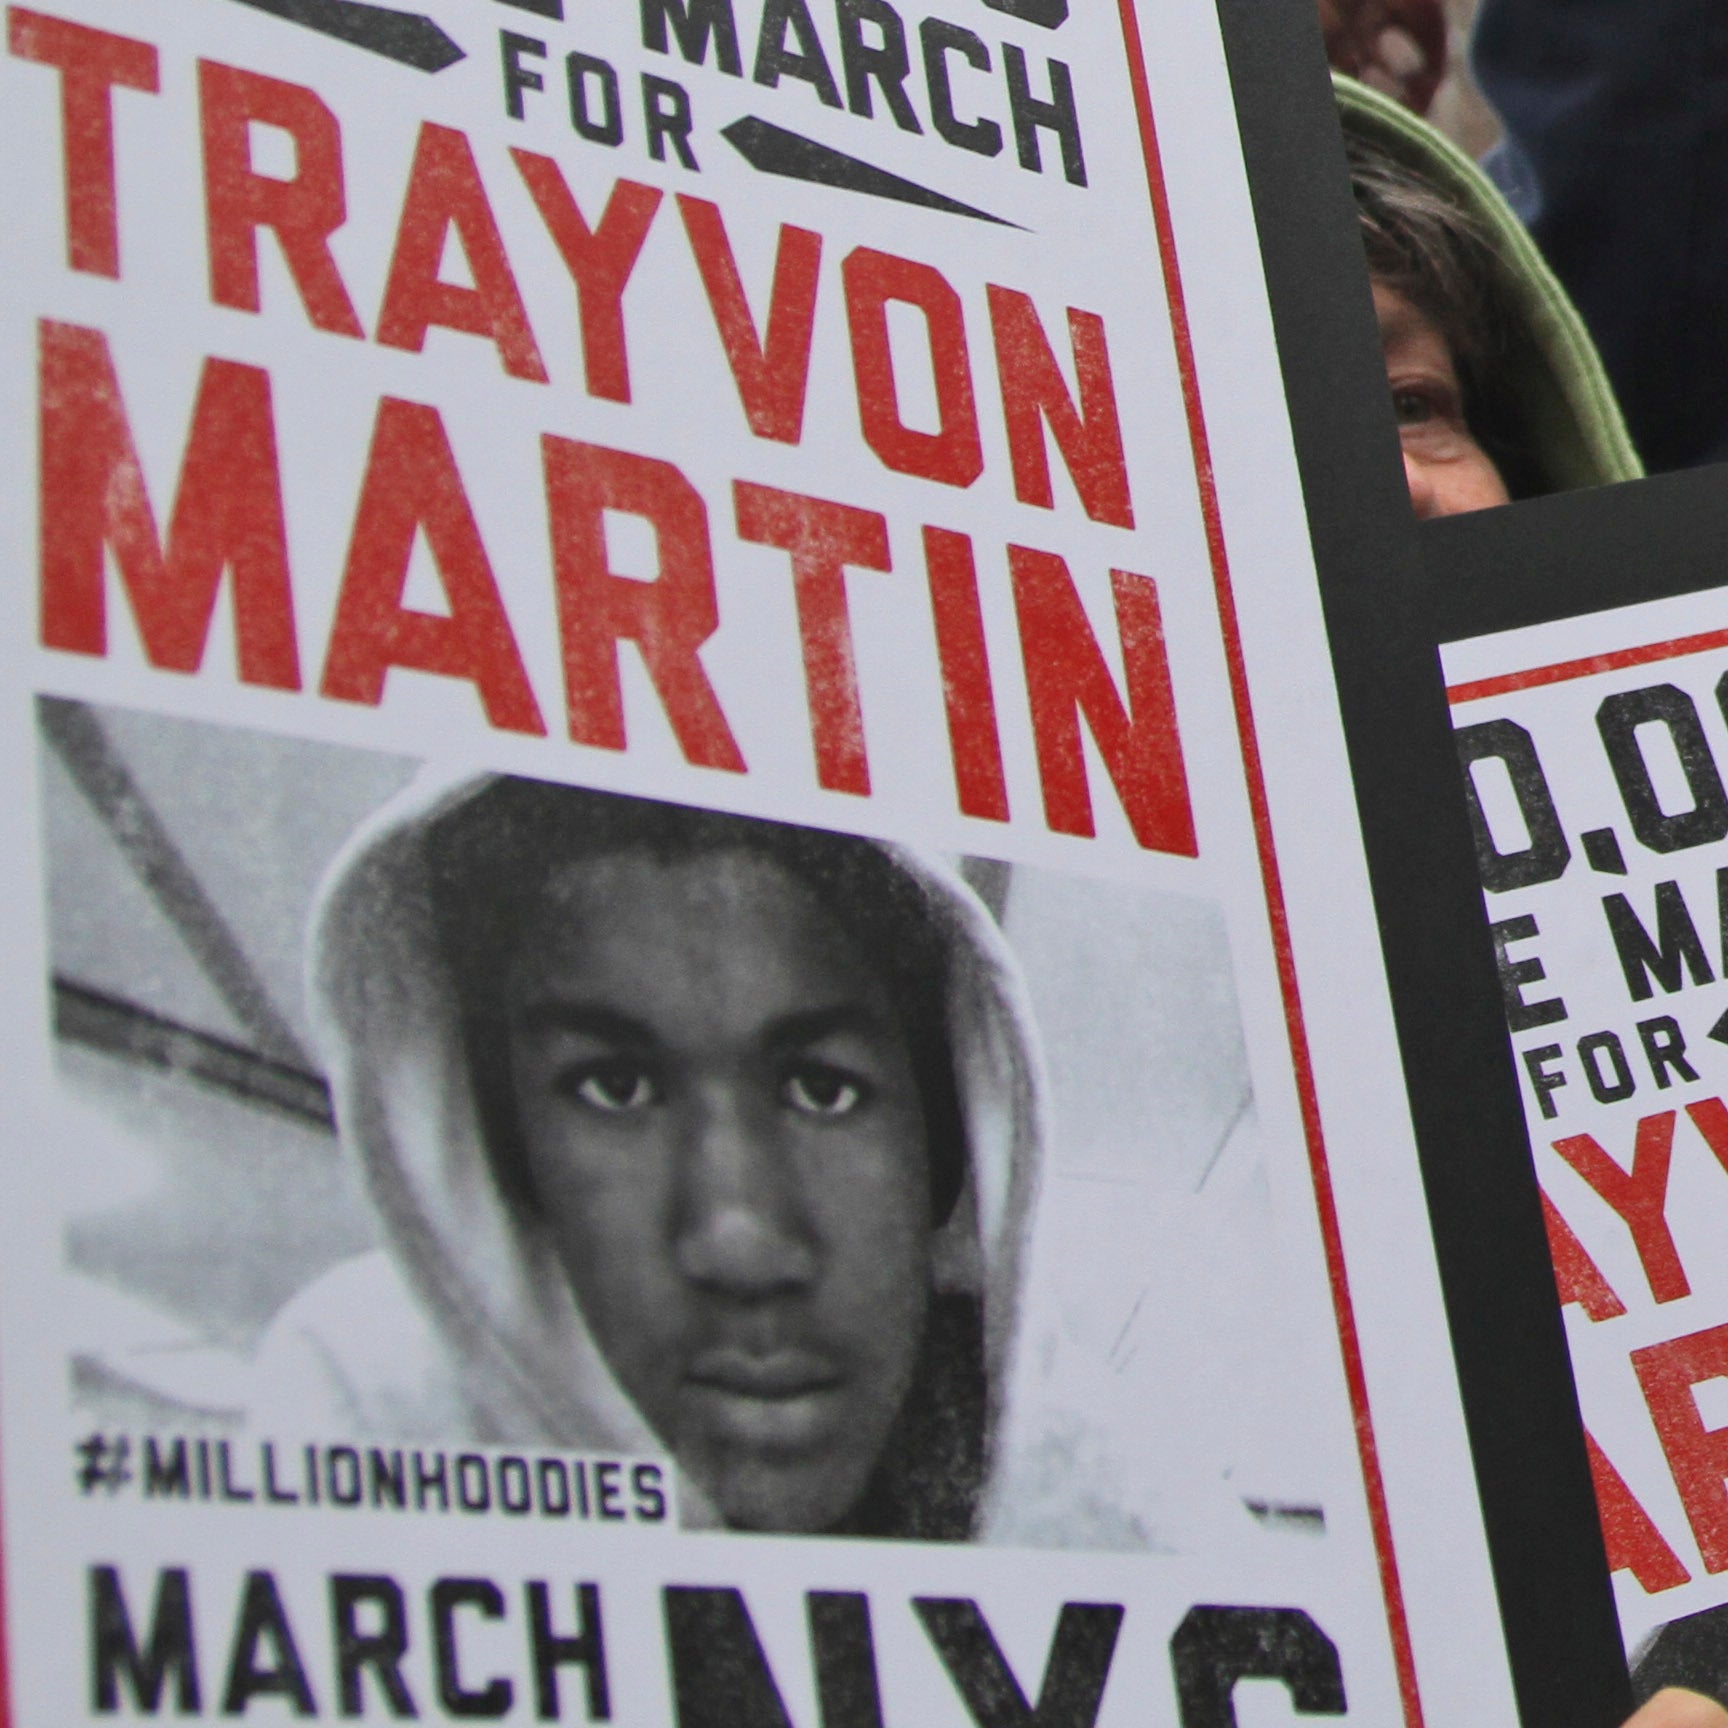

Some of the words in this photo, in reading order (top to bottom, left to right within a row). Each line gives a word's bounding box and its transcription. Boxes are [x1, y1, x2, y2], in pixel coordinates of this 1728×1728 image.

[499, 30, 700, 172] FOR
[6, 4, 1136, 531] TRAYVON
[36, 315, 1200, 860] MARTIN
[1523, 1013, 1700, 1119] FOR
[72, 1431, 668, 1522] #MILLIONHOODIES
[87, 1564, 614, 1724] MARCH
